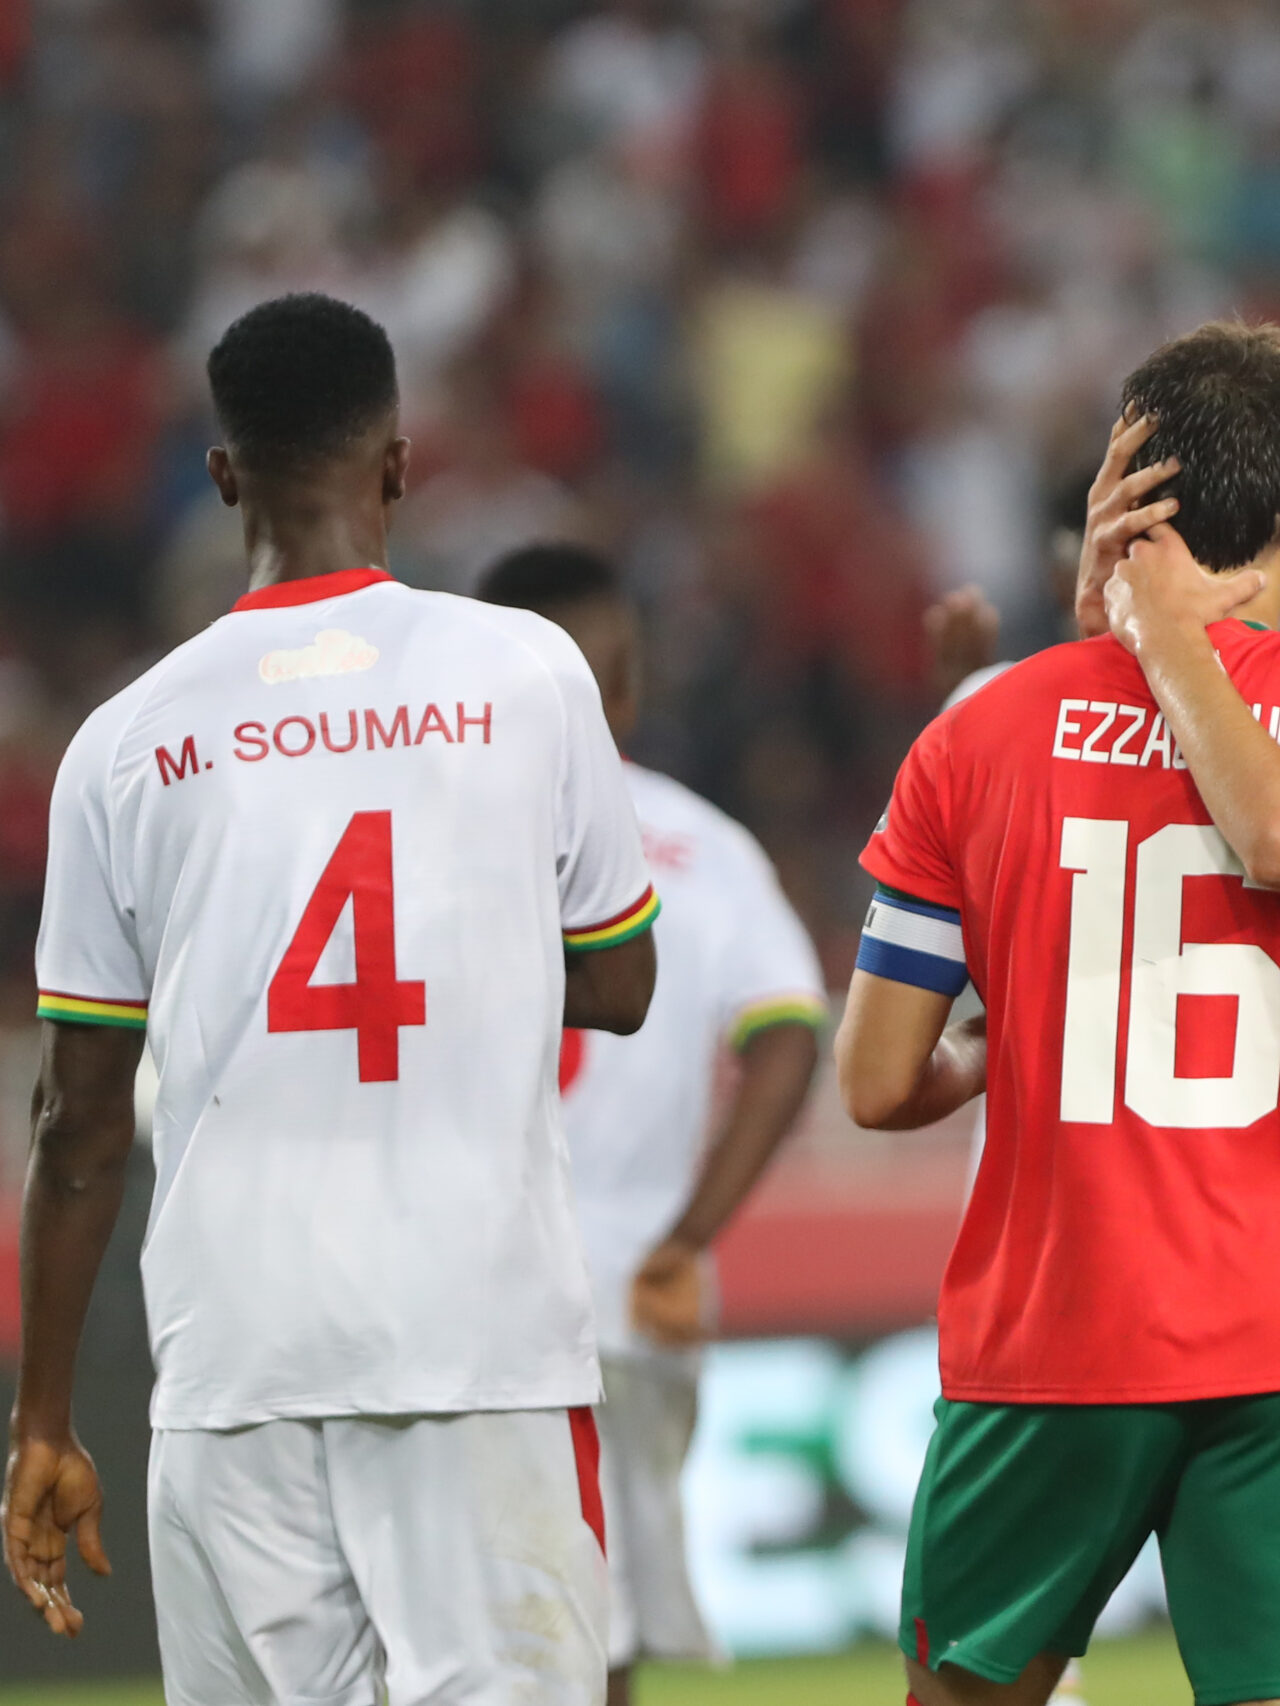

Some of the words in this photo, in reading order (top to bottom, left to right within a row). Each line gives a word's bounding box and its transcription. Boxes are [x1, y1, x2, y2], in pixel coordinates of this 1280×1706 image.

[155, 735, 214, 787] M.
[233, 701, 493, 763] SOUMAH
[267, 810, 427, 1084] 4
